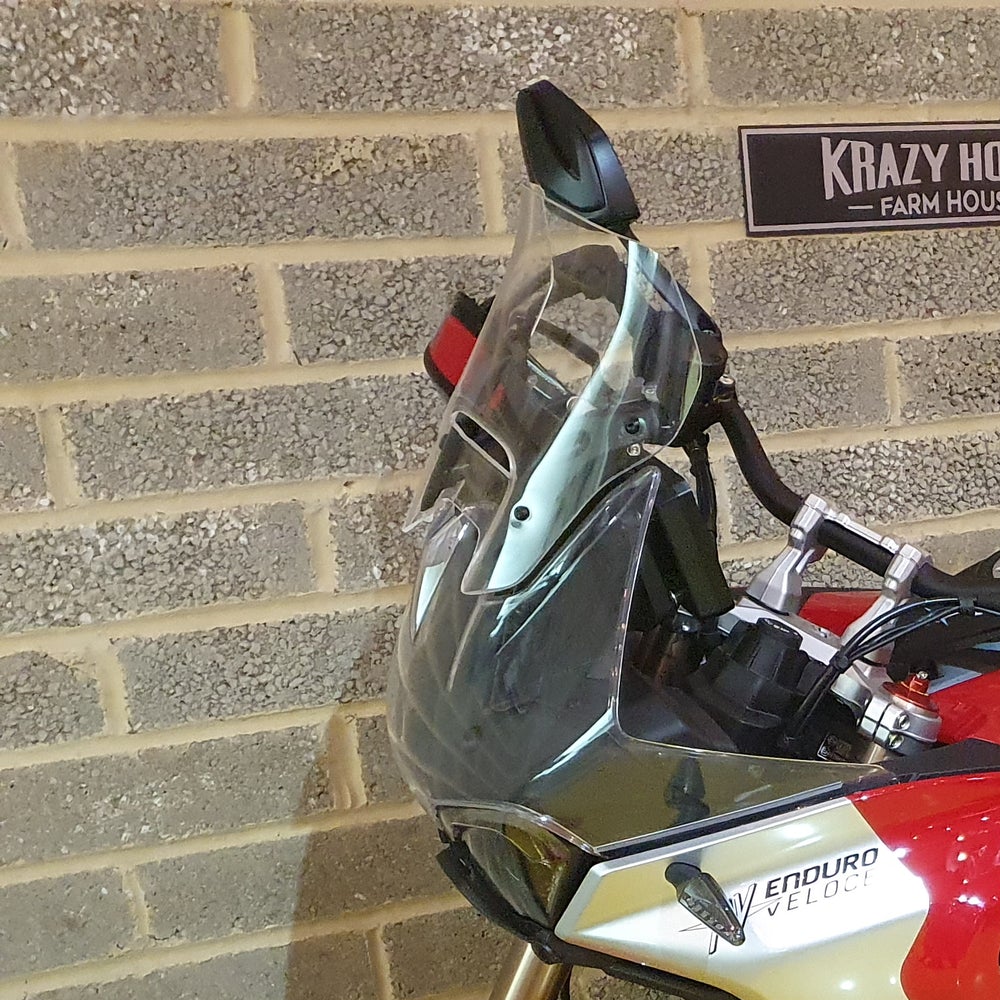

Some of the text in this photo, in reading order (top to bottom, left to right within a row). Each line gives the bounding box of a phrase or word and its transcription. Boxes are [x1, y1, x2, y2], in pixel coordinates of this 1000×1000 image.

[820, 136, 950, 200] KRAZY
[880, 191, 940, 216] FARM
[765, 847, 879, 899] ENDURO
